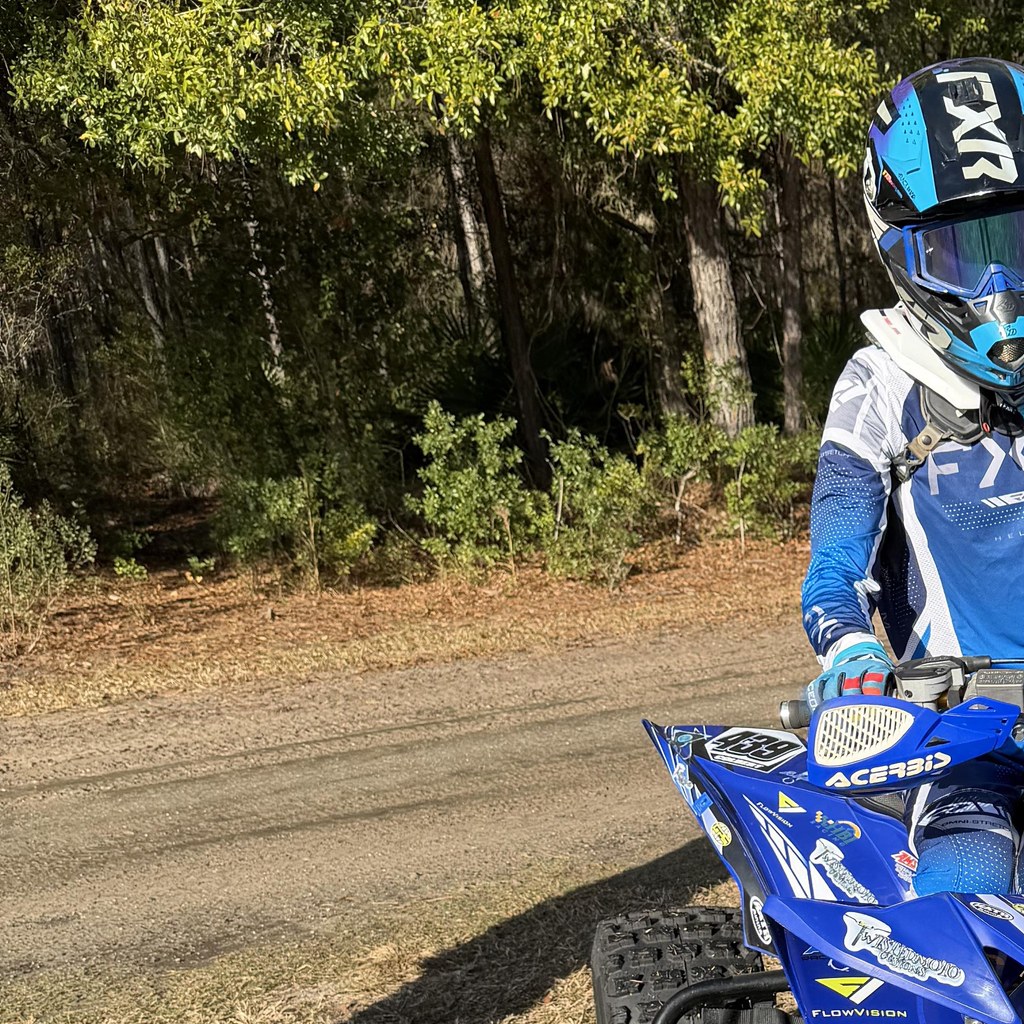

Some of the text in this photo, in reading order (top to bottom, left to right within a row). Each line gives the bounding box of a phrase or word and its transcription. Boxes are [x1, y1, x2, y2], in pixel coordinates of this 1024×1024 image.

[936, 71, 1019, 184] FXR
[711, 730, 803, 762] 439
[824, 751, 953, 789] ACERBIS
[811, 1008, 908, 1018] FLOWVISION
